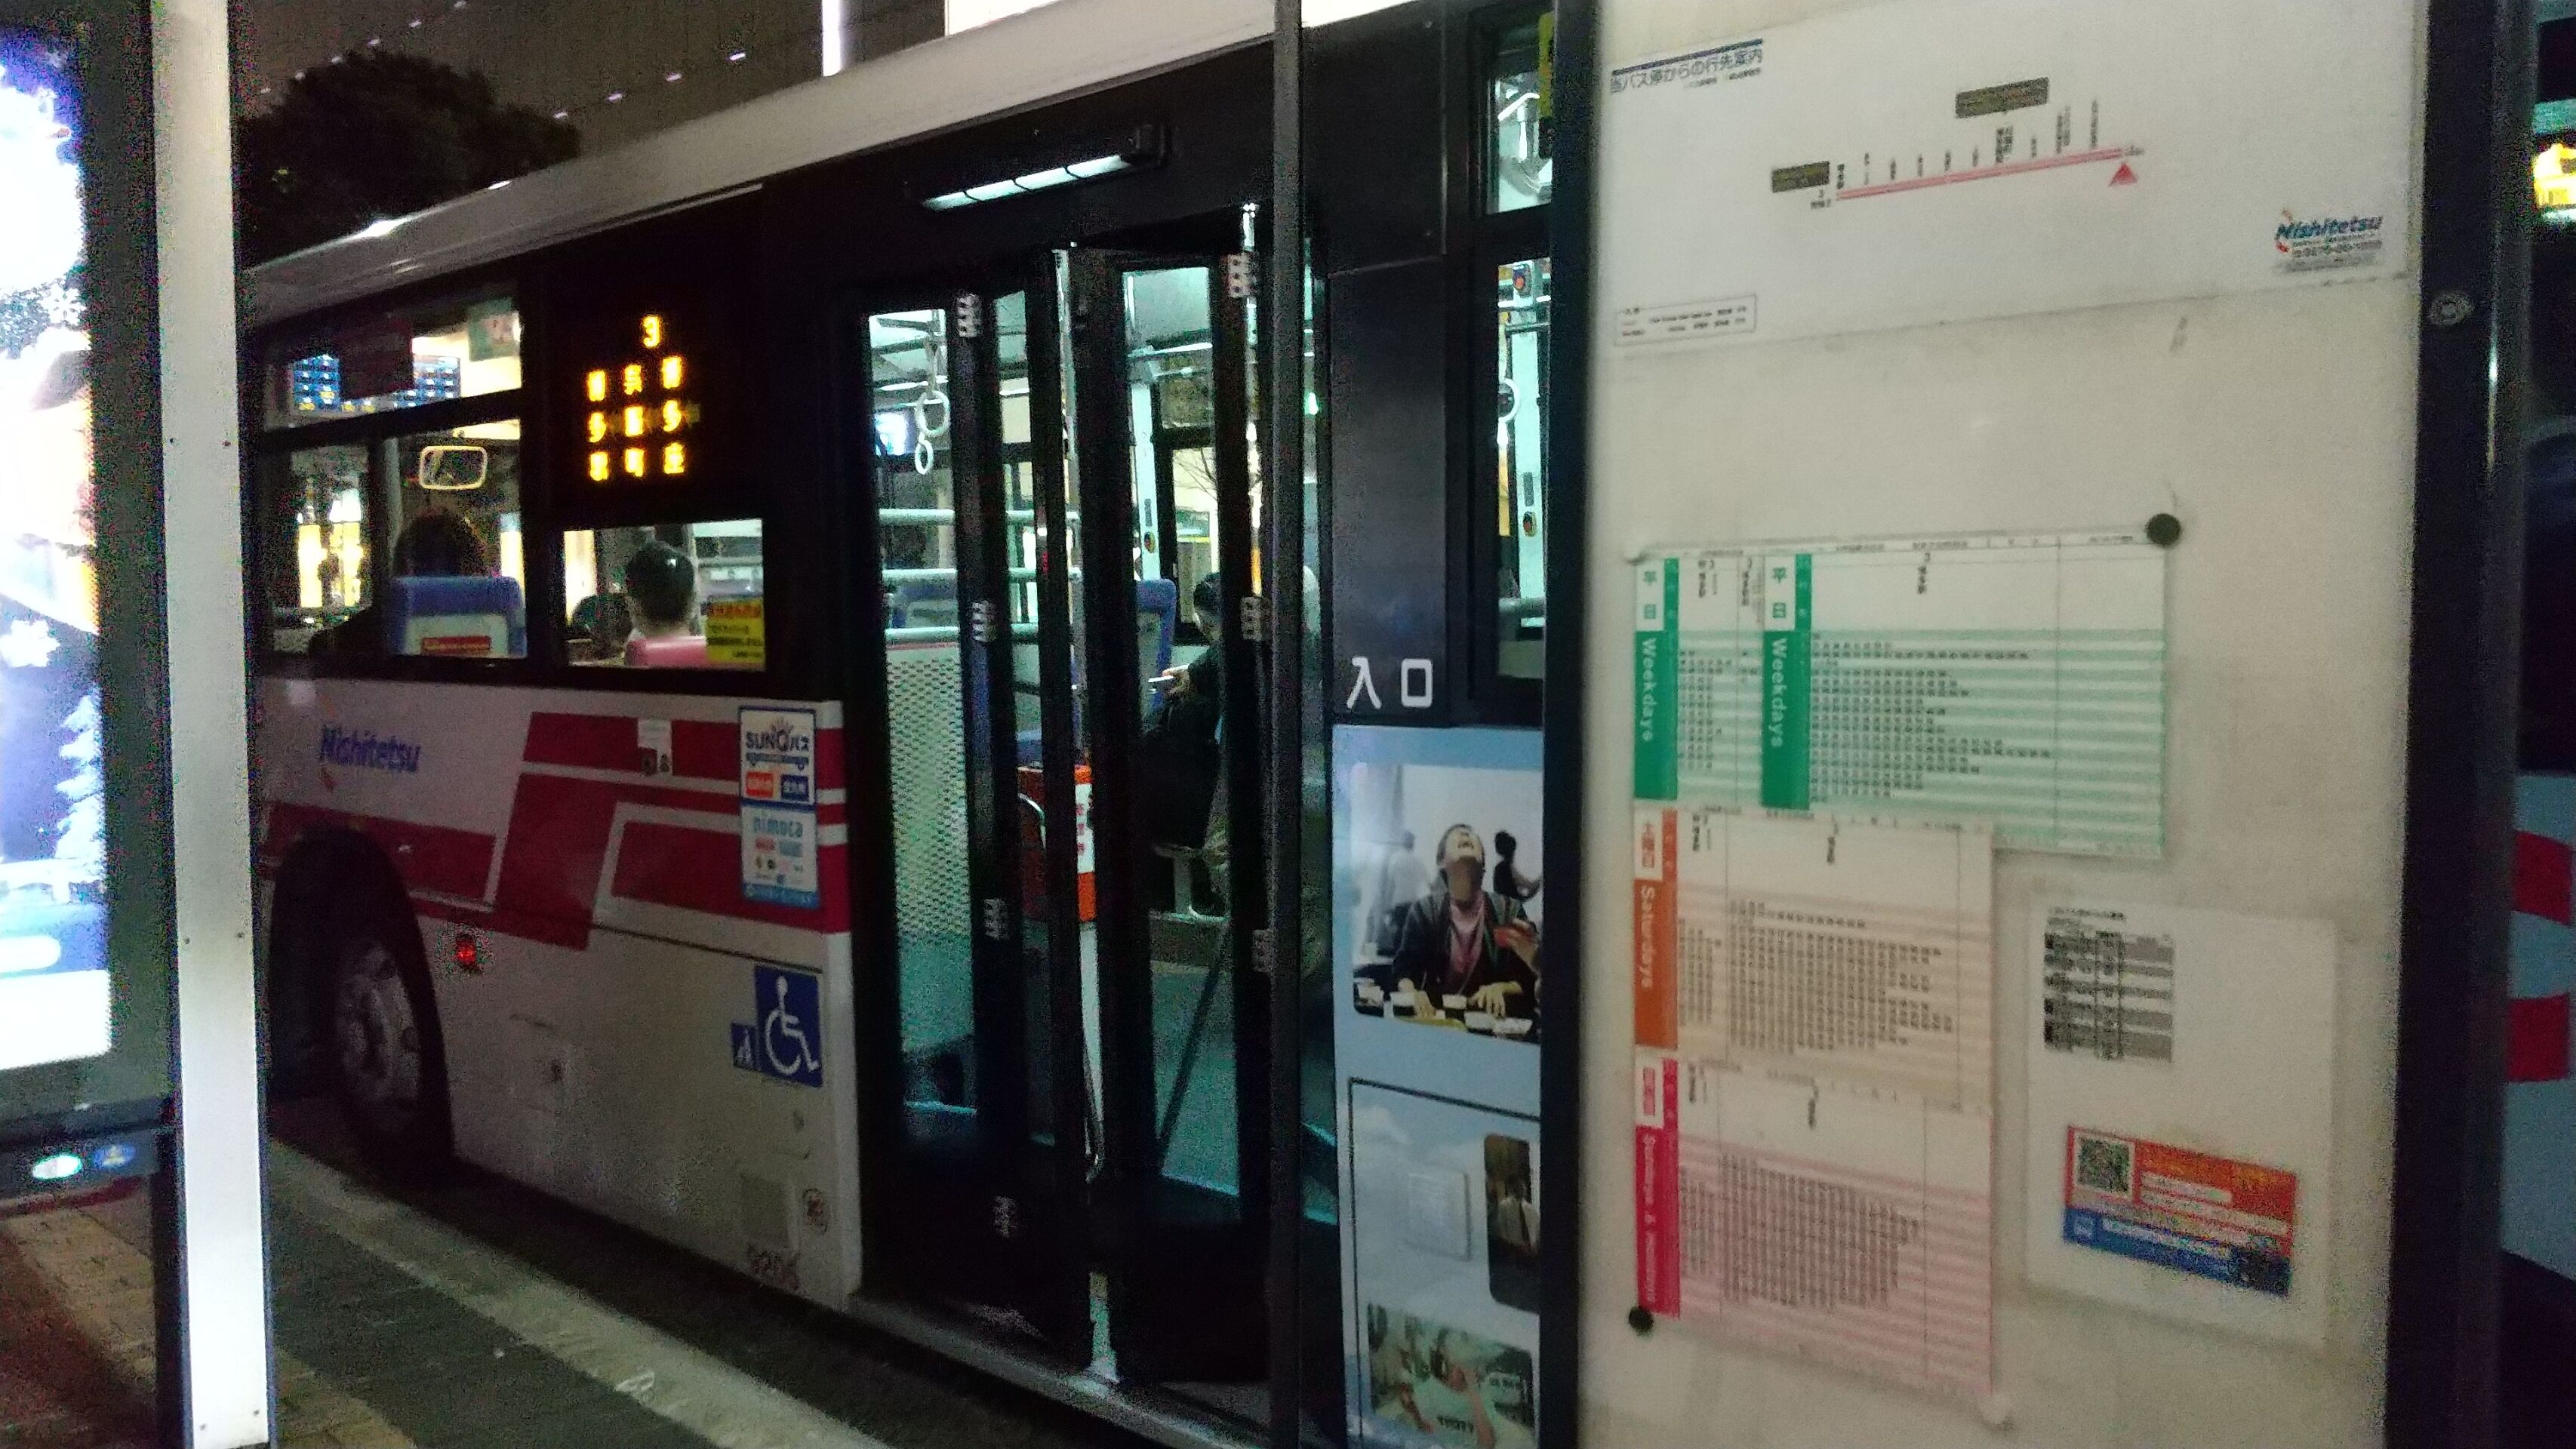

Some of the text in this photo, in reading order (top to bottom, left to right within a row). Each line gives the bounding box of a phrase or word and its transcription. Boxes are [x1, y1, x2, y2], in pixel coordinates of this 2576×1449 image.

[2274, 216, 2384, 241] Nishitetsu
[642, 315, 660, 348] 3
[1346, 656, 1433, 709] 入口
[1640, 638, 1657, 742] Weekdays
[1768, 638, 1787, 748] Weekdays
[319, 724, 421, 773] Nishitetsu
